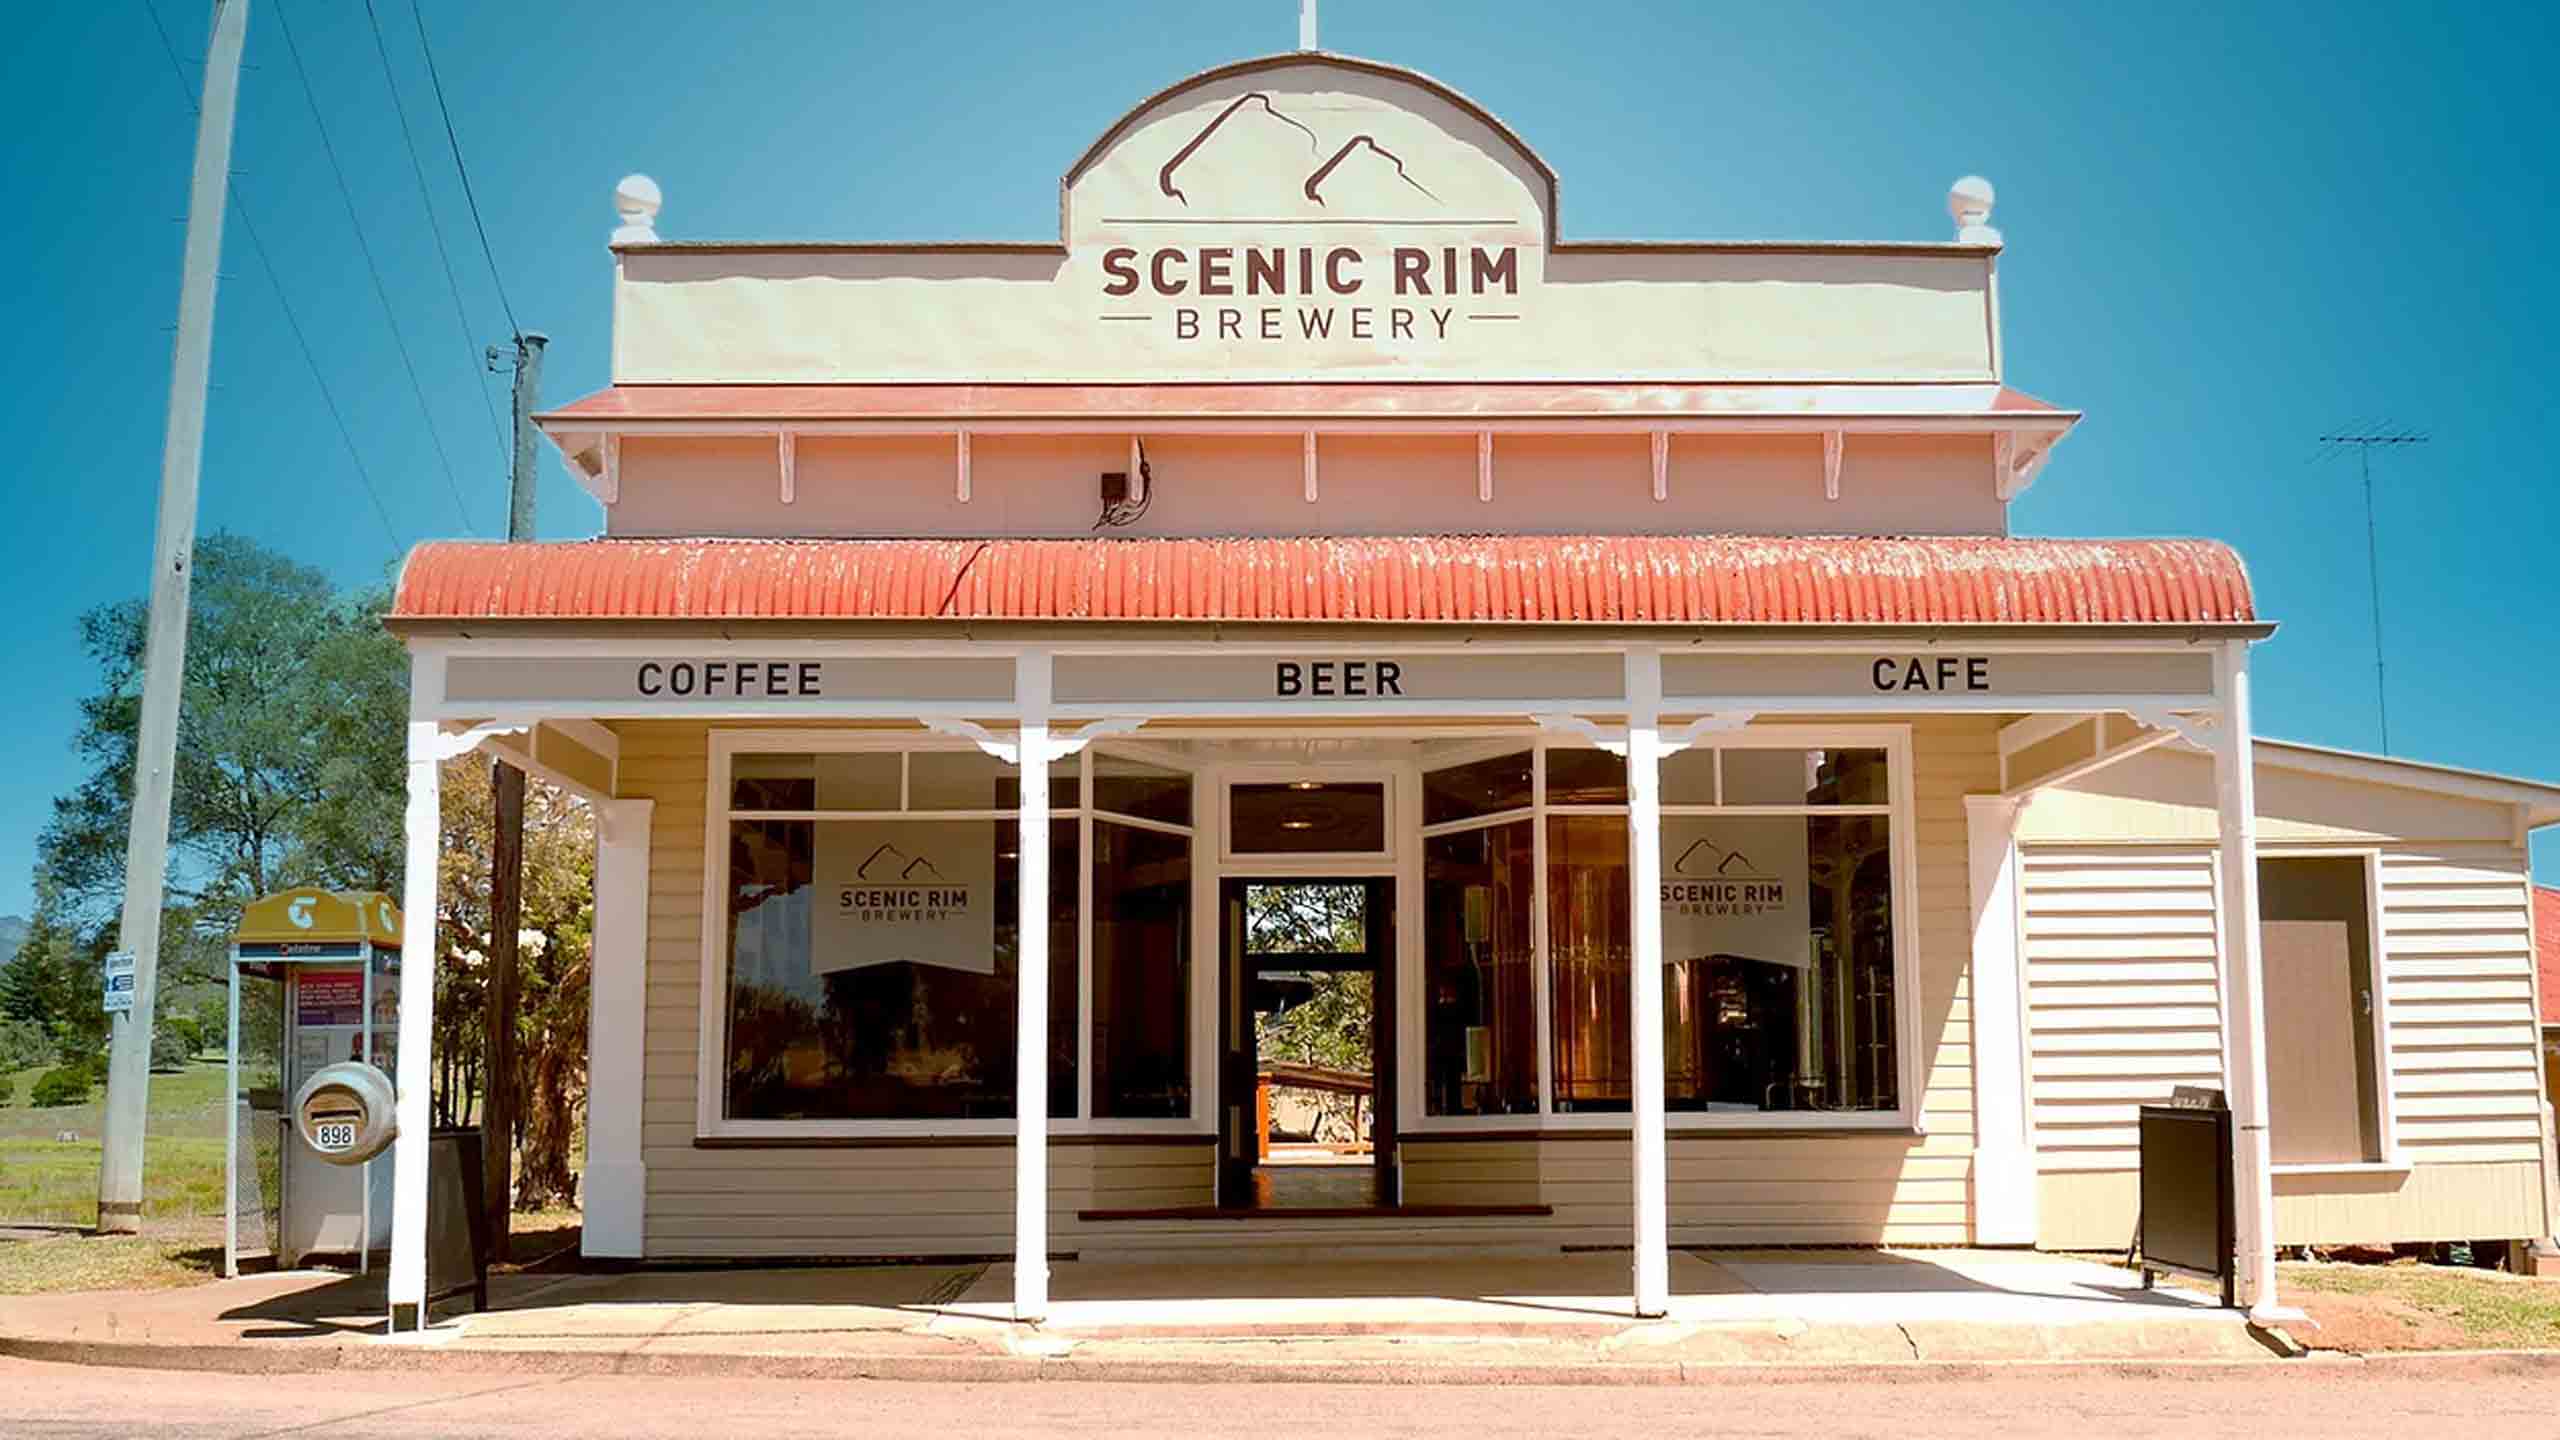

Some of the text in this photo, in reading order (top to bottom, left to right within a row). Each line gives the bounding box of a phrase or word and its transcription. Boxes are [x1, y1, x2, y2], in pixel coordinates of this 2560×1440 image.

[1102, 247, 1518, 296] SCENIC RIM
[1176, 308, 1453, 340] BREWERY
[638, 662, 821, 696] COFFEE
[1277, 661, 1402, 696] BEER
[1872, 657, 1989, 691] CAFE
[840, 890, 968, 907] SCENIC RIM
[1660, 884, 1783, 902] SCENIC RIM
[862, 909, 948, 922] BREWERY
[1680, 903, 1764, 916] BREWERY
[321, 1126, 351, 1144] 898
